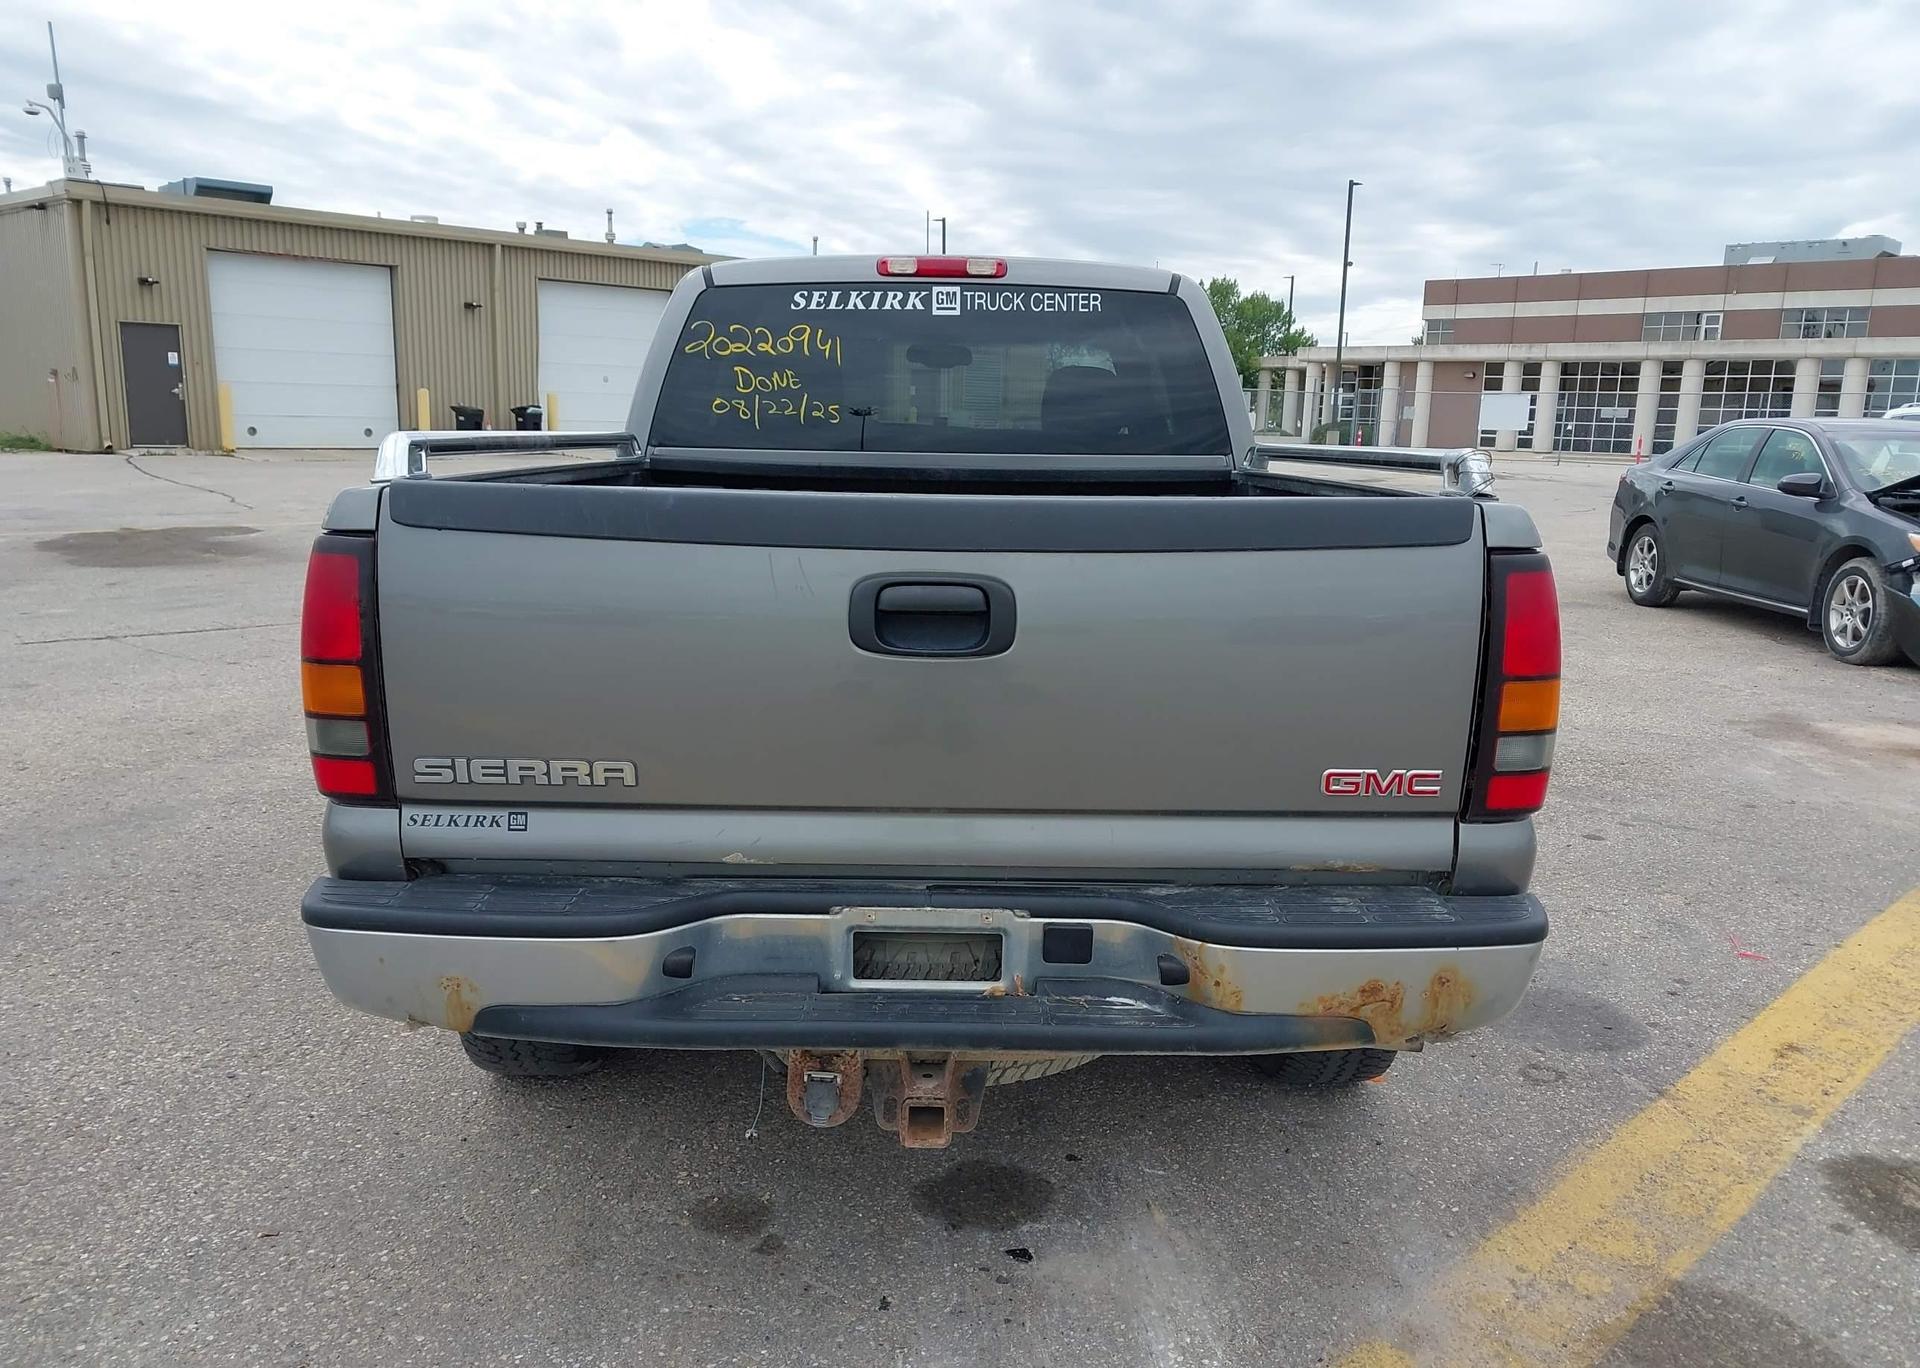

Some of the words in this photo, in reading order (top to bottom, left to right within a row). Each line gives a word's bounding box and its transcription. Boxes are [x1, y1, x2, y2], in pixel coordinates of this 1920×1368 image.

[790, 290, 929, 310] SELKIRK
[935, 290, 958, 310] GM
[963, 291, 1025, 312] TRUCK
[1030, 292, 1102, 312] CENTER
[684, 320, 842, 367] 20220941
[733, 366, 802, 393] DONE
[711, 393, 841, 430] 08/22/25
[413, 757, 638, 787] SIERRA
[1322, 768, 1443, 797] GMC
[406, 813, 505, 828] SELKIRK
[509, 814, 526, 829] GM
